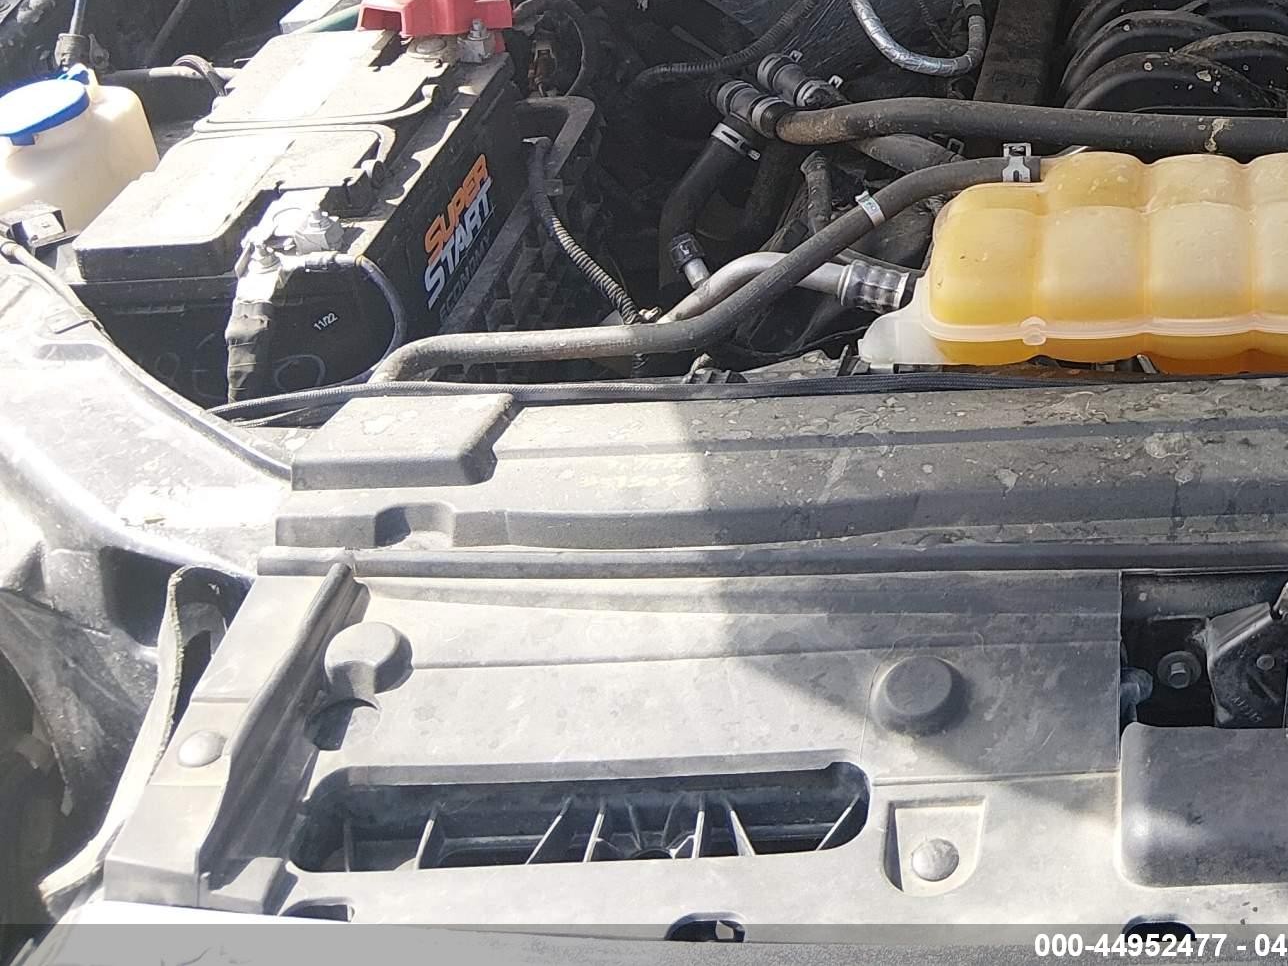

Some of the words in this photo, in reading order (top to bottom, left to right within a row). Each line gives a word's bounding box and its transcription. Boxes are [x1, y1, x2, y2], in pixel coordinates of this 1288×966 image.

[424, 153, 488, 266] SUPER
[424, 176, 493, 310] START
[313, 312, 338, 331] 11/22
